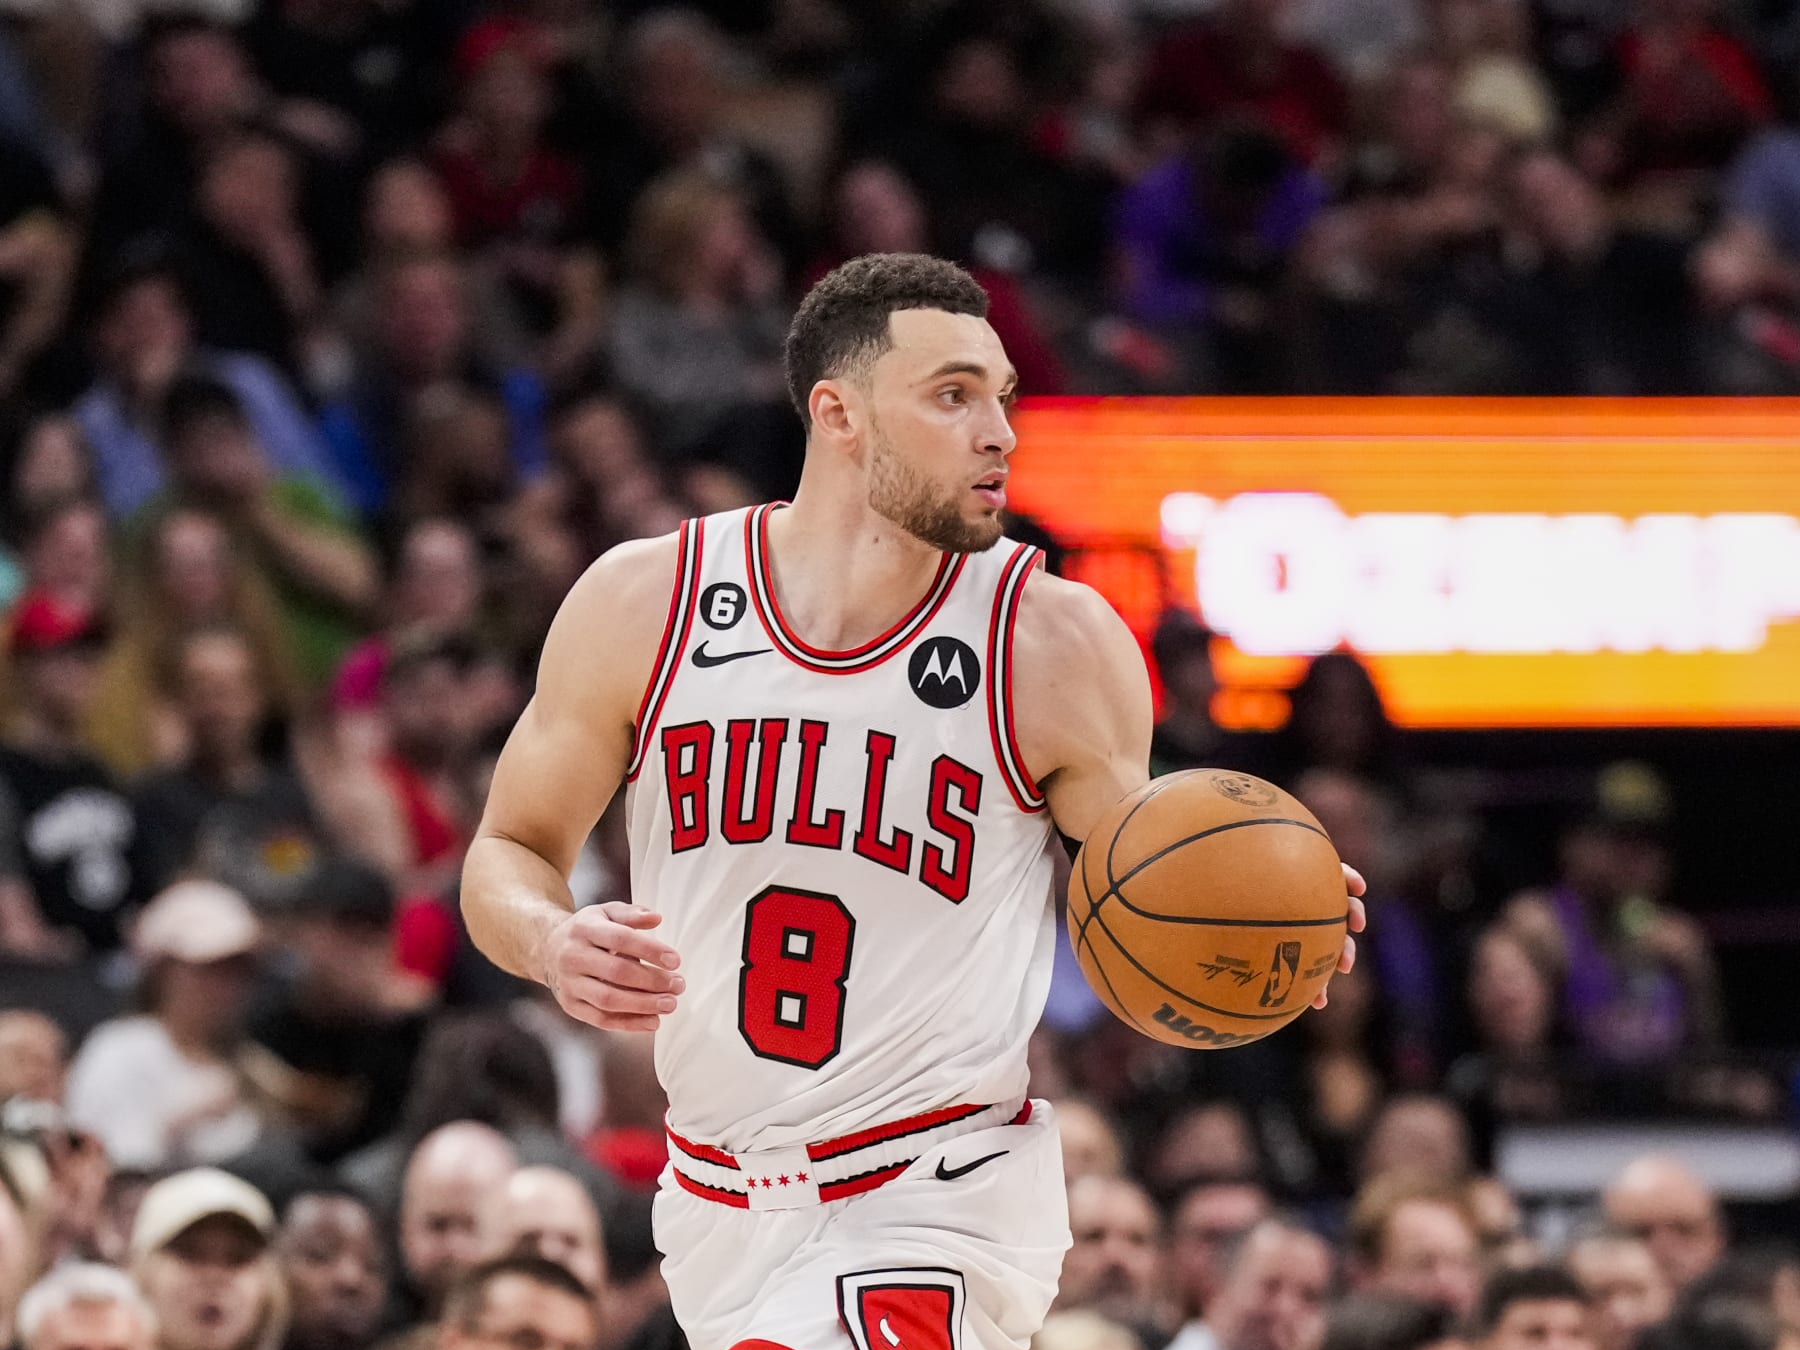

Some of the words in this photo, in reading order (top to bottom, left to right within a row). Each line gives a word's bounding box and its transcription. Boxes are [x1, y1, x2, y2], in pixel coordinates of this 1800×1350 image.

[709, 589, 739, 625] 6
[661, 718, 983, 904] BULLS
[738, 885, 856, 1071] 8
